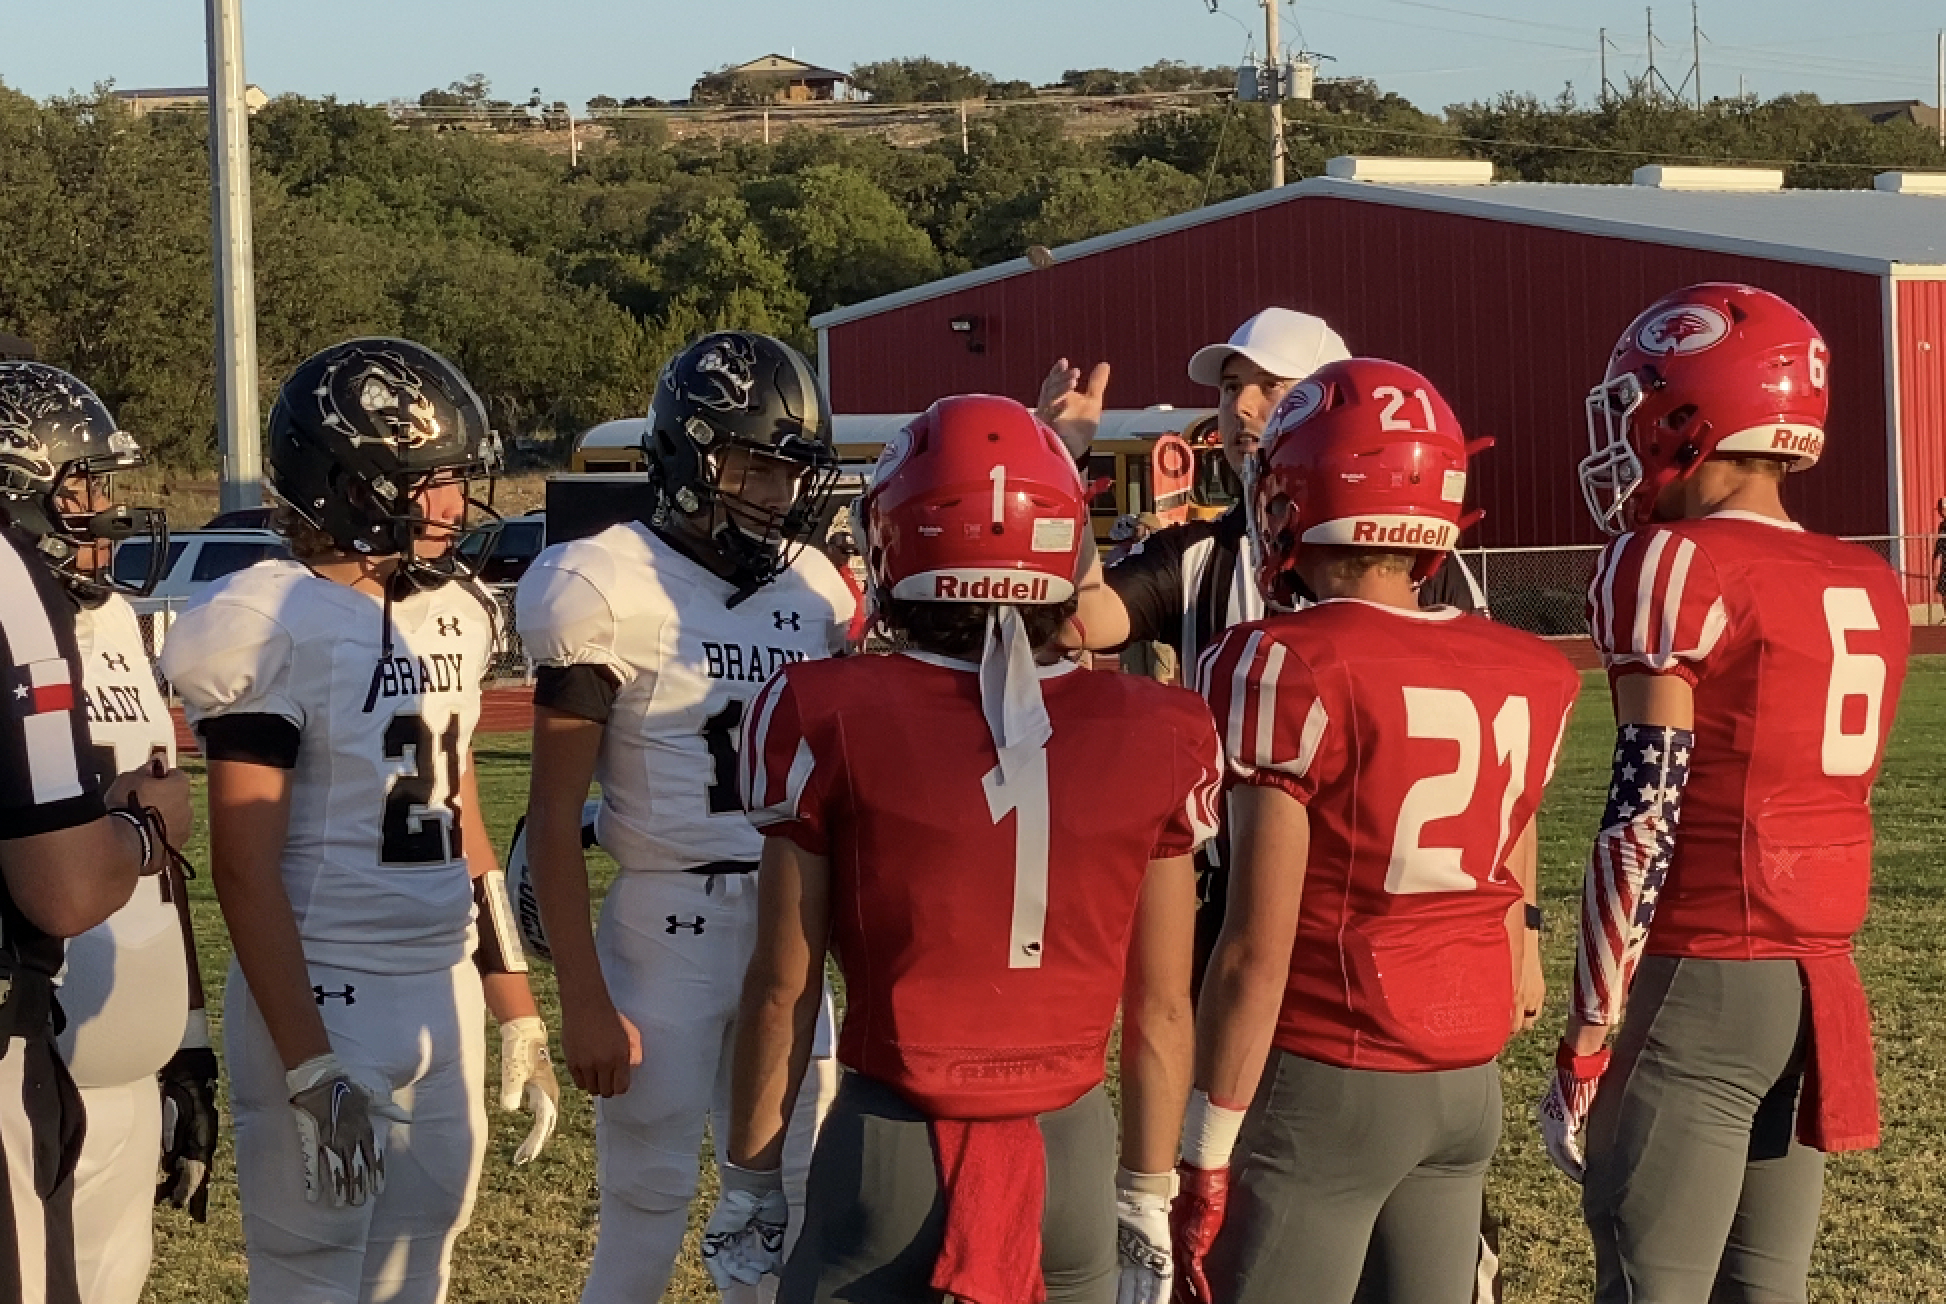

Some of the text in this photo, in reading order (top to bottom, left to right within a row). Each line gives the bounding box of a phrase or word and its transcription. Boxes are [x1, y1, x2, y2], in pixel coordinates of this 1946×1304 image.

[1808, 337, 1830, 389] 6
[1372, 385, 1437, 433] 21
[990, 464, 1006, 523] 1
[1352, 521, 1450, 546] Riddell
[935, 575, 1049, 601] Riddell
[382, 654, 463, 697] BRADY
[1822, 587, 1887, 776] 6
[379, 712, 464, 866] 21
[1384, 686, 1531, 894] 21
[981, 747, 1050, 969] 1
